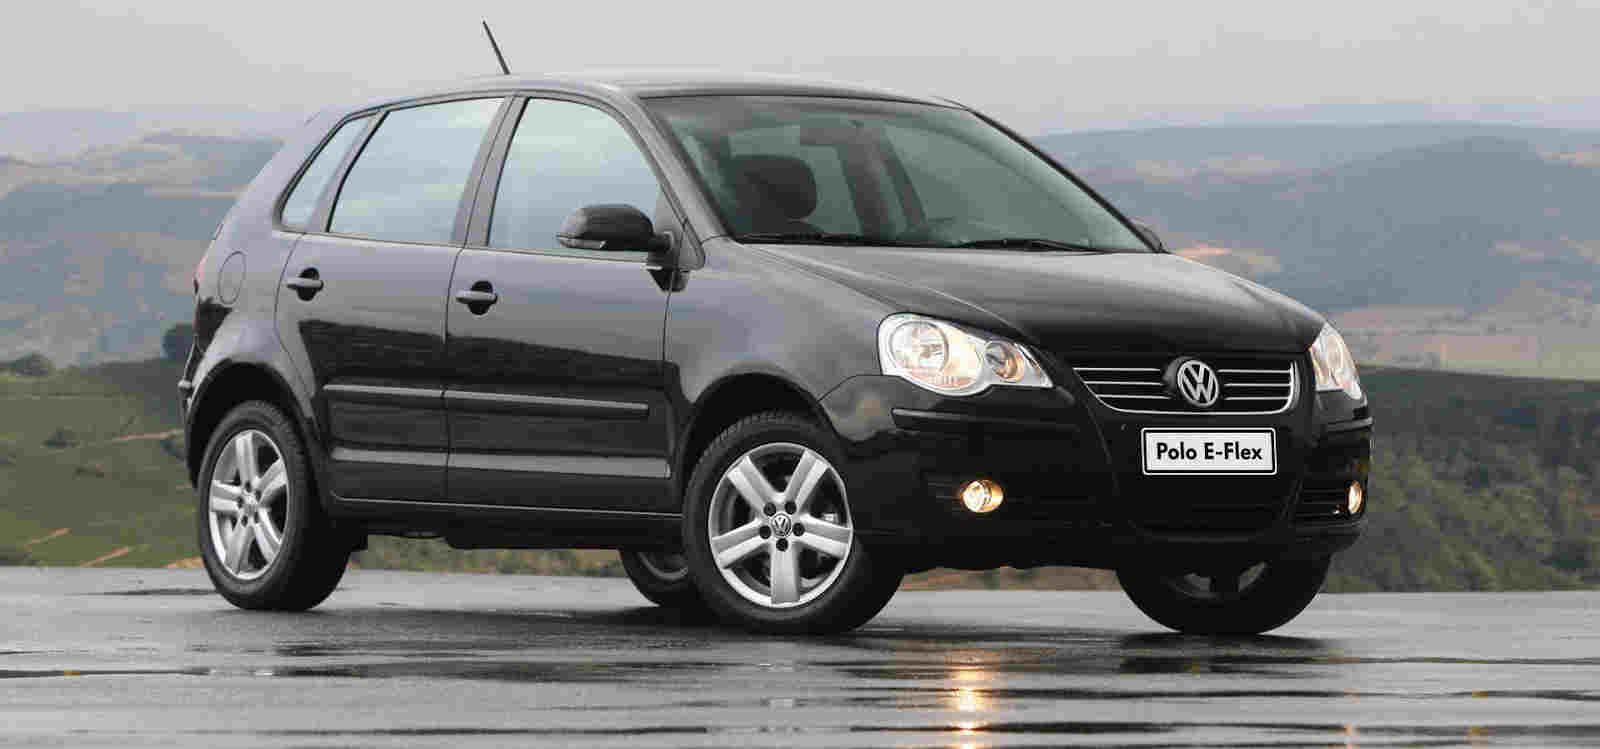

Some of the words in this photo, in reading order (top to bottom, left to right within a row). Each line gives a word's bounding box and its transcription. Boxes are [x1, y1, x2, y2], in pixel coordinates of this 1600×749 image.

[1180, 362, 1217, 405] VW
[1157, 441, 1197, 460] Polo
[1204, 441, 1262, 460] E-Flex
